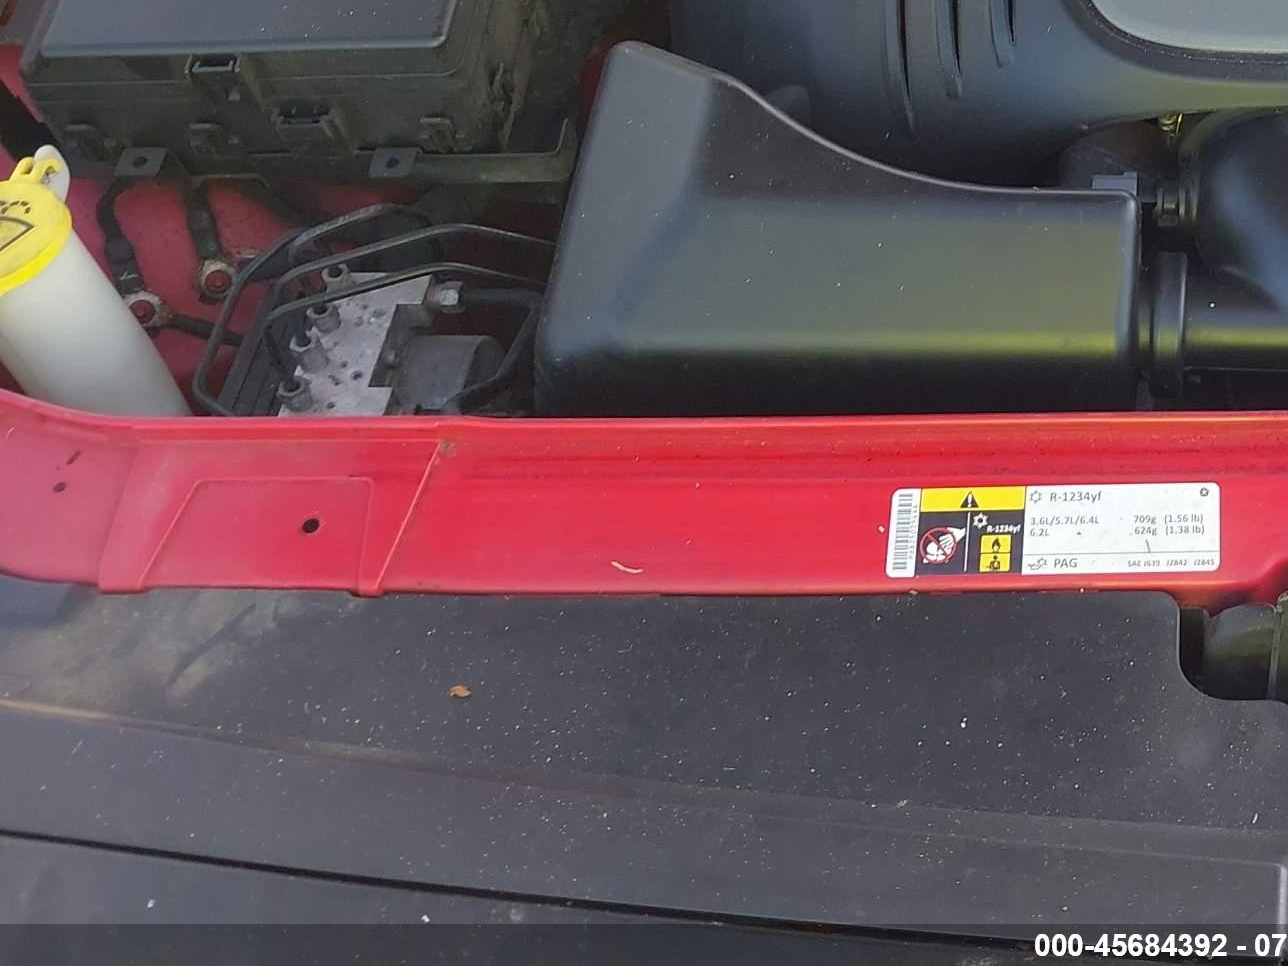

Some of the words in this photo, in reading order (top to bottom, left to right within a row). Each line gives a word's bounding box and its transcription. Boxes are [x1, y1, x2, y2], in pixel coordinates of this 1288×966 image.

[1049, 491, 1102, 503] R-1234yf
[1133, 514, 1157, 525] 709g
[1030, 528, 1050, 537] 6.2L
[1134, 526, 1158, 537] 624g
[1054, 558, 1078, 569] PAG
